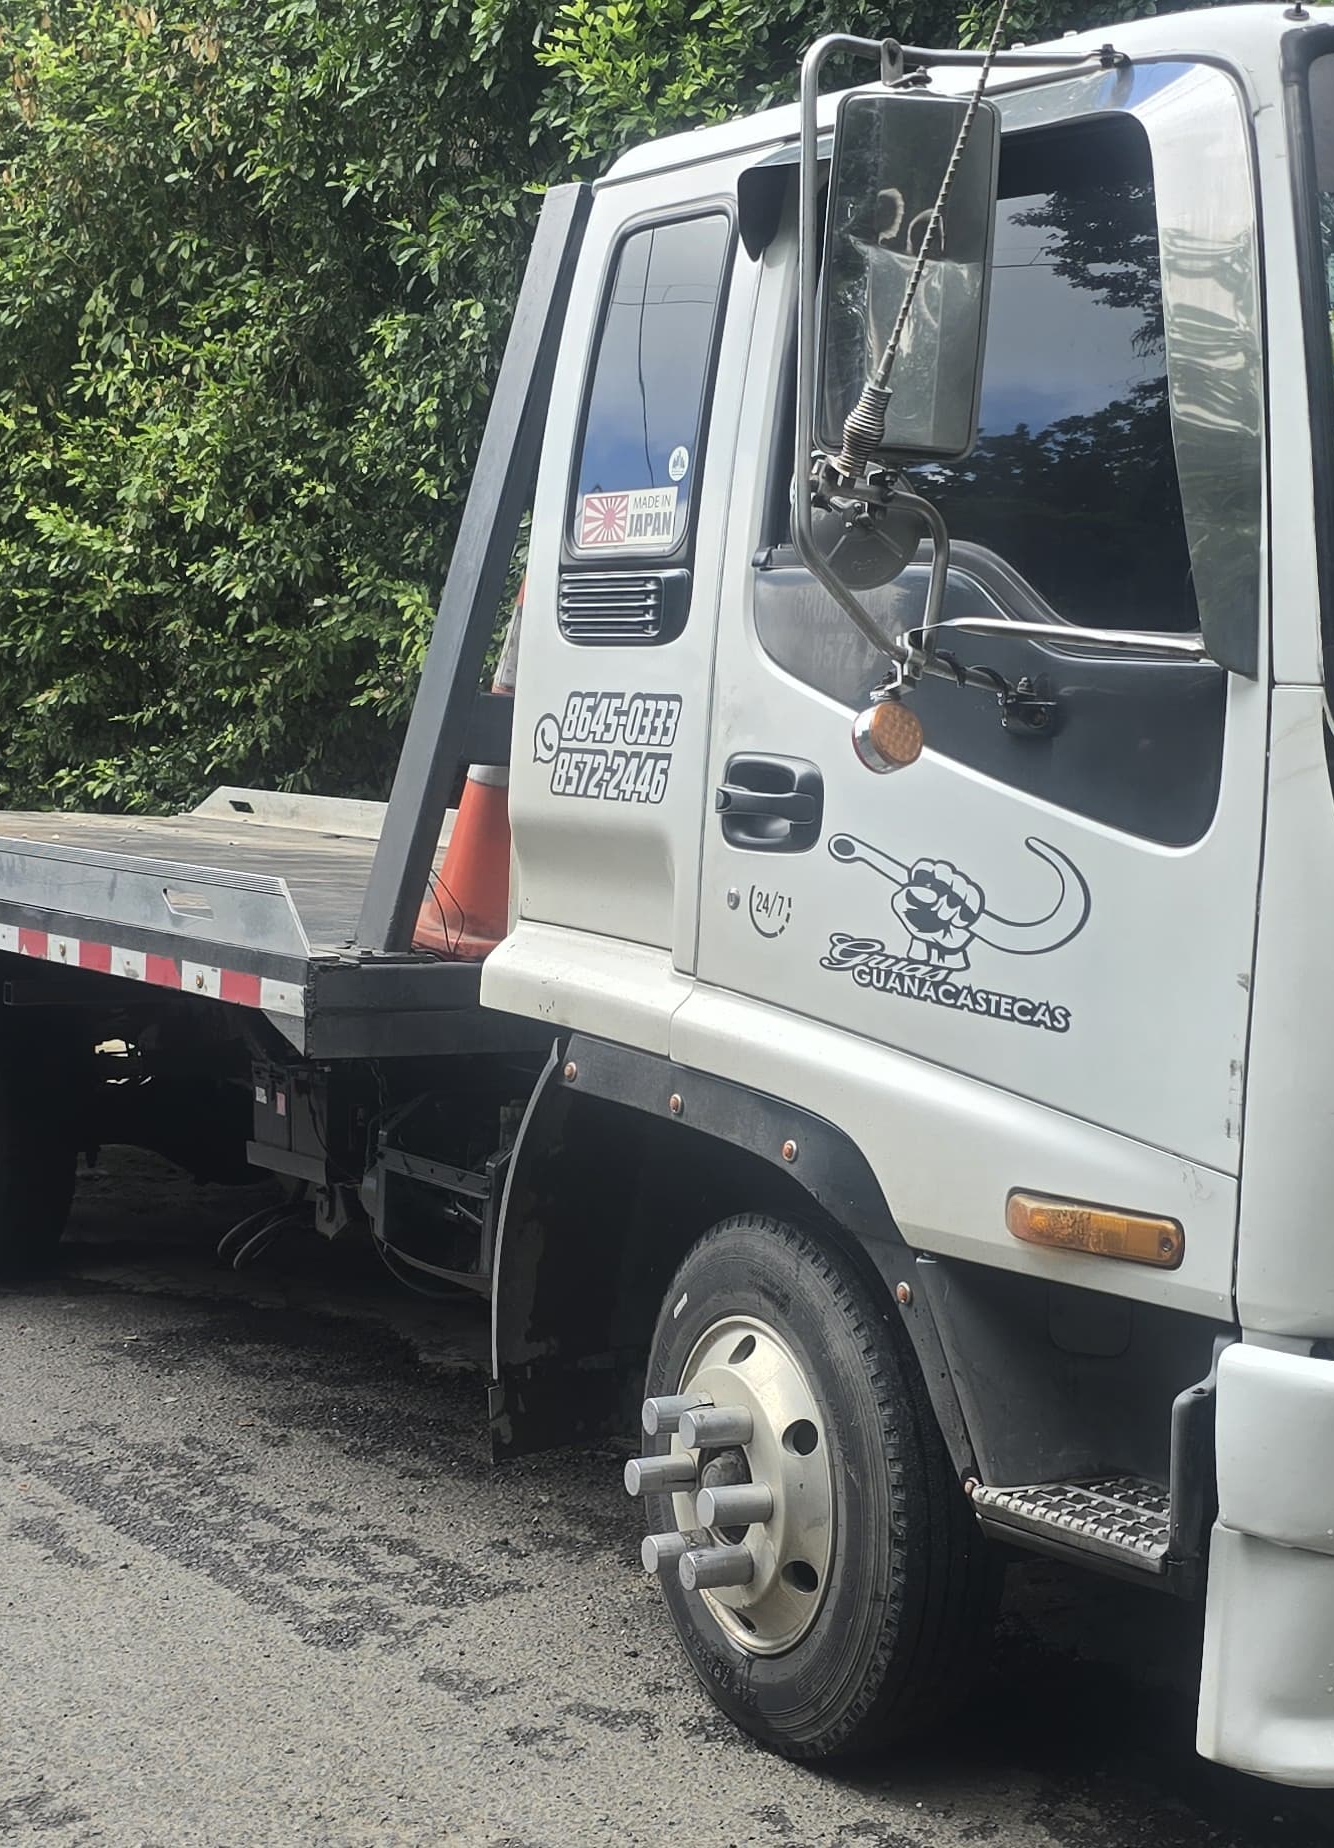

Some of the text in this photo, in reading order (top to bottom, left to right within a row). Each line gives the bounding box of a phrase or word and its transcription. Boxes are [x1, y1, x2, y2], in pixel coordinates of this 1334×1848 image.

[628, 512, 672, 537] JAPAN
[633, 494, 671, 510] MADE IN
[561, 693, 681, 746] 8645-0333
[551, 749, 671, 803] 8572-2446
[756, 891, 784, 918] 24/7
[820, 934, 948, 982] Gruas
[853, 964, 1070, 1031] GUANACASTECAS
